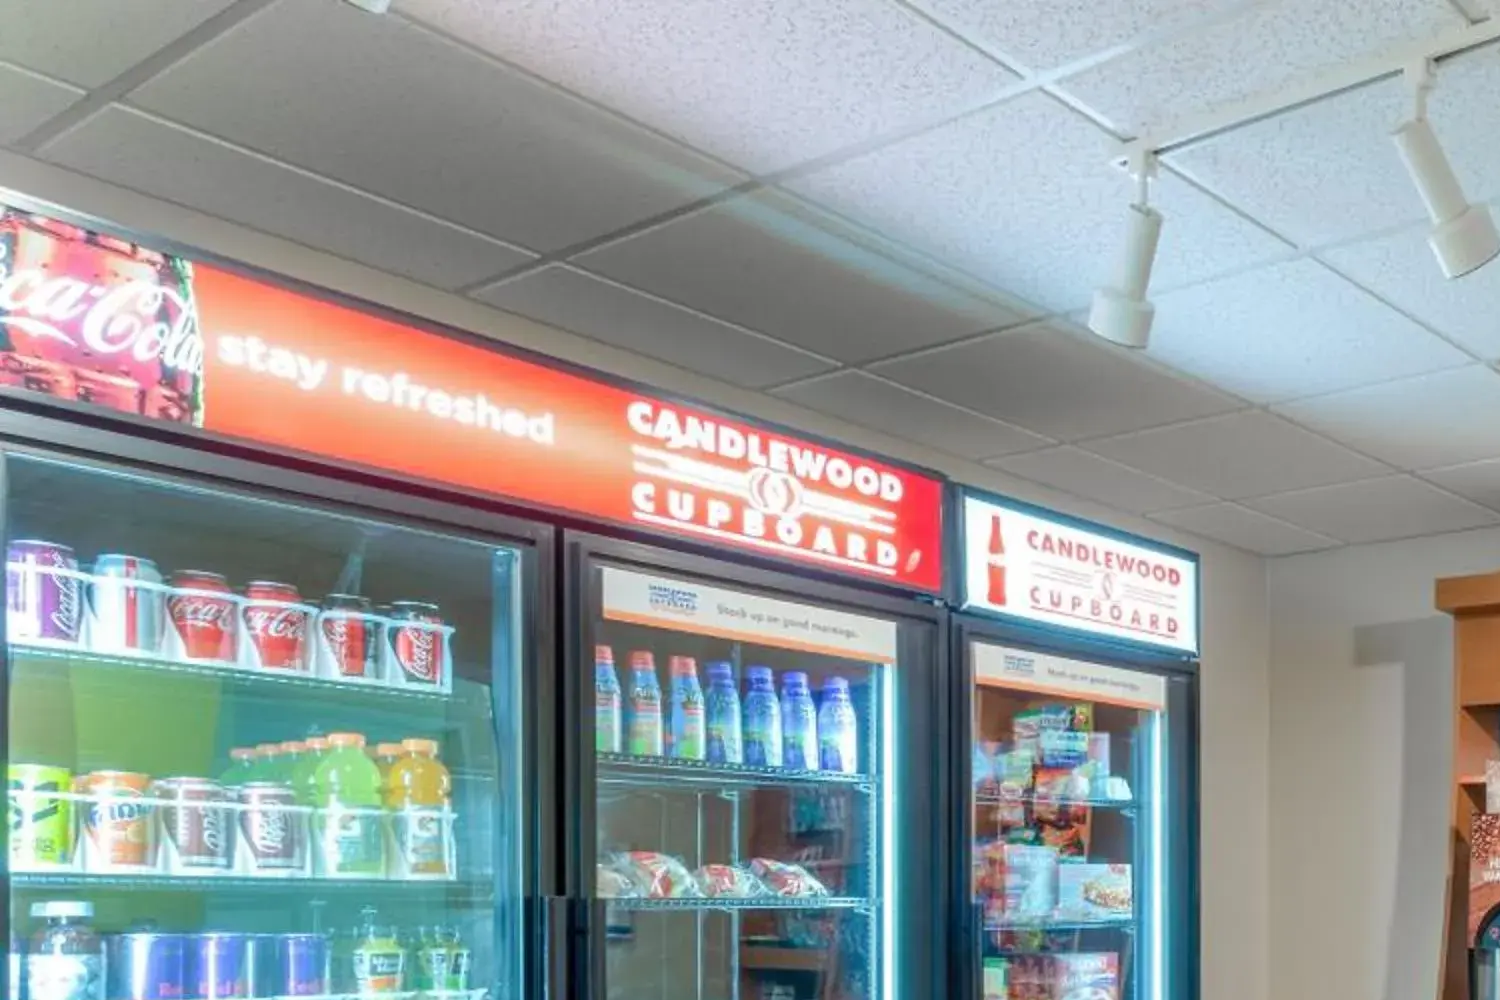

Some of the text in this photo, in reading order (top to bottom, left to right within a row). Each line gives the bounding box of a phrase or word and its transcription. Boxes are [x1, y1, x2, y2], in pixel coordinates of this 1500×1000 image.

[217, 333, 556, 447] stay refreshed
[626, 401, 904, 503] CANDLEWOOD
[630, 480, 900, 570] CUPBOARD
[1025, 529, 1182, 588] CANDLEWOOD
[1028, 584, 1181, 636] CUPBOARD
